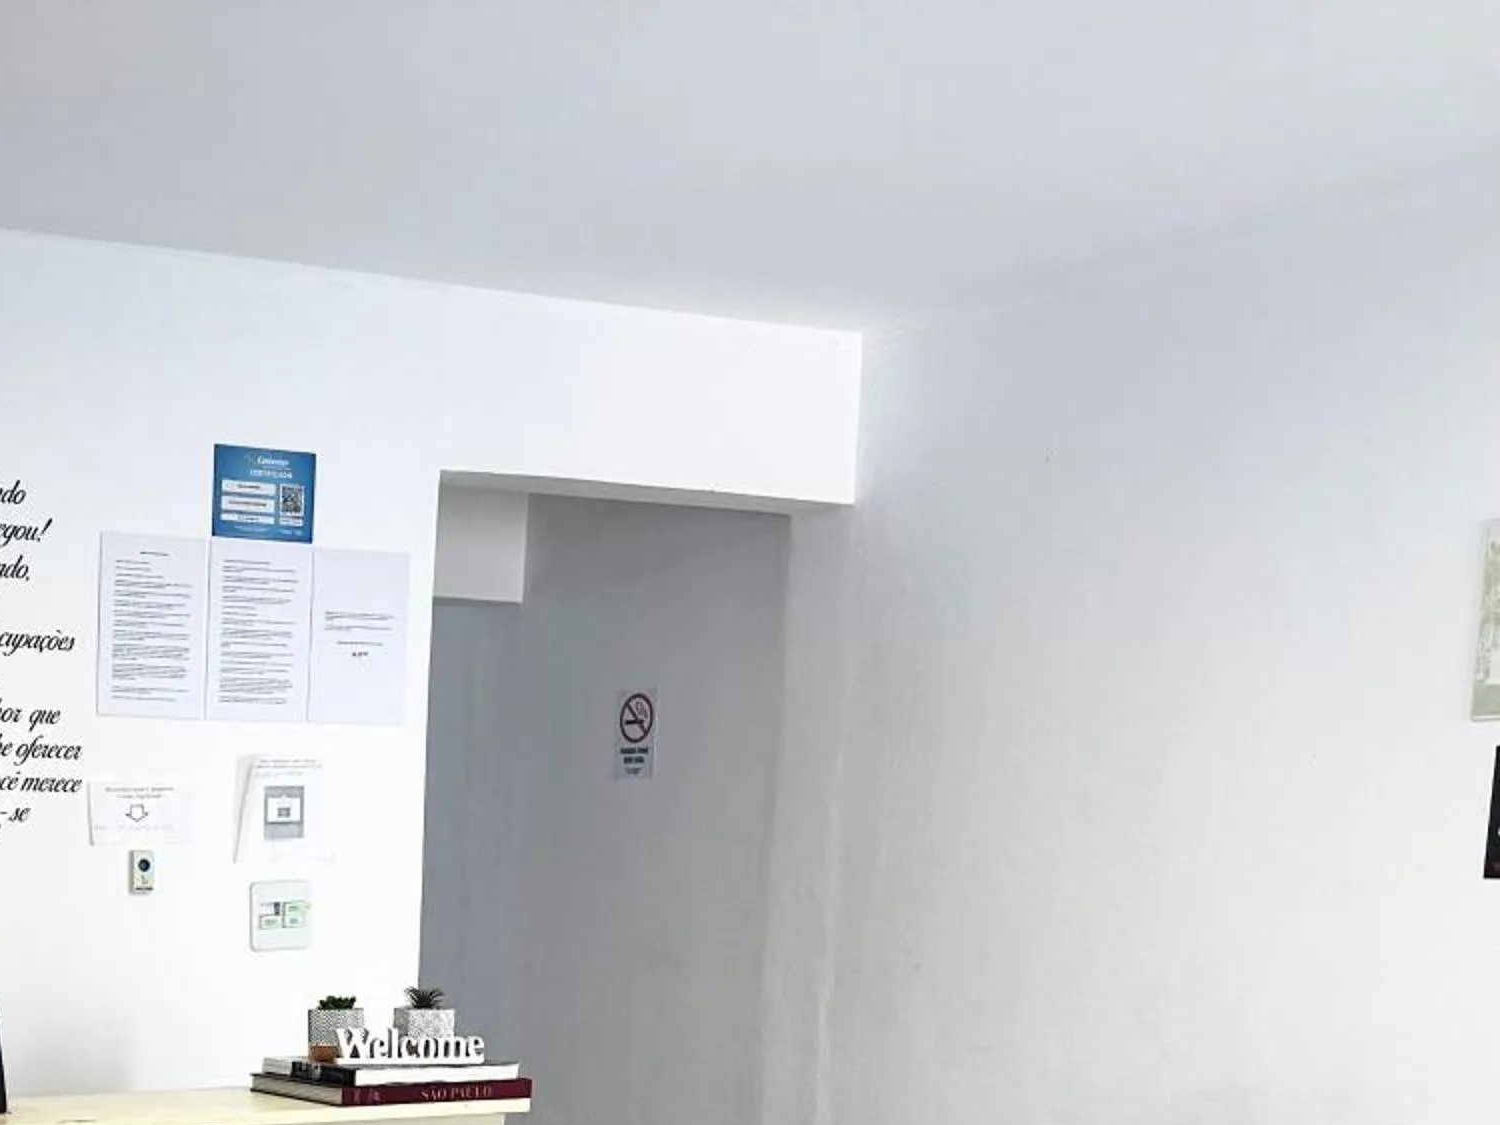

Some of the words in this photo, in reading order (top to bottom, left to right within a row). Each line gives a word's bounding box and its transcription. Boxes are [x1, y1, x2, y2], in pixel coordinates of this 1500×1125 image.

[28, 709, 61, 732] que
[13, 735, 83, 766] oferecer
[20, 776, 83, 794] merece
[335, 1028, 484, 1060] Welcome
[420, 1087, 447, 1101] SÃO
[451, 1085, 493, 1099] PAULO
